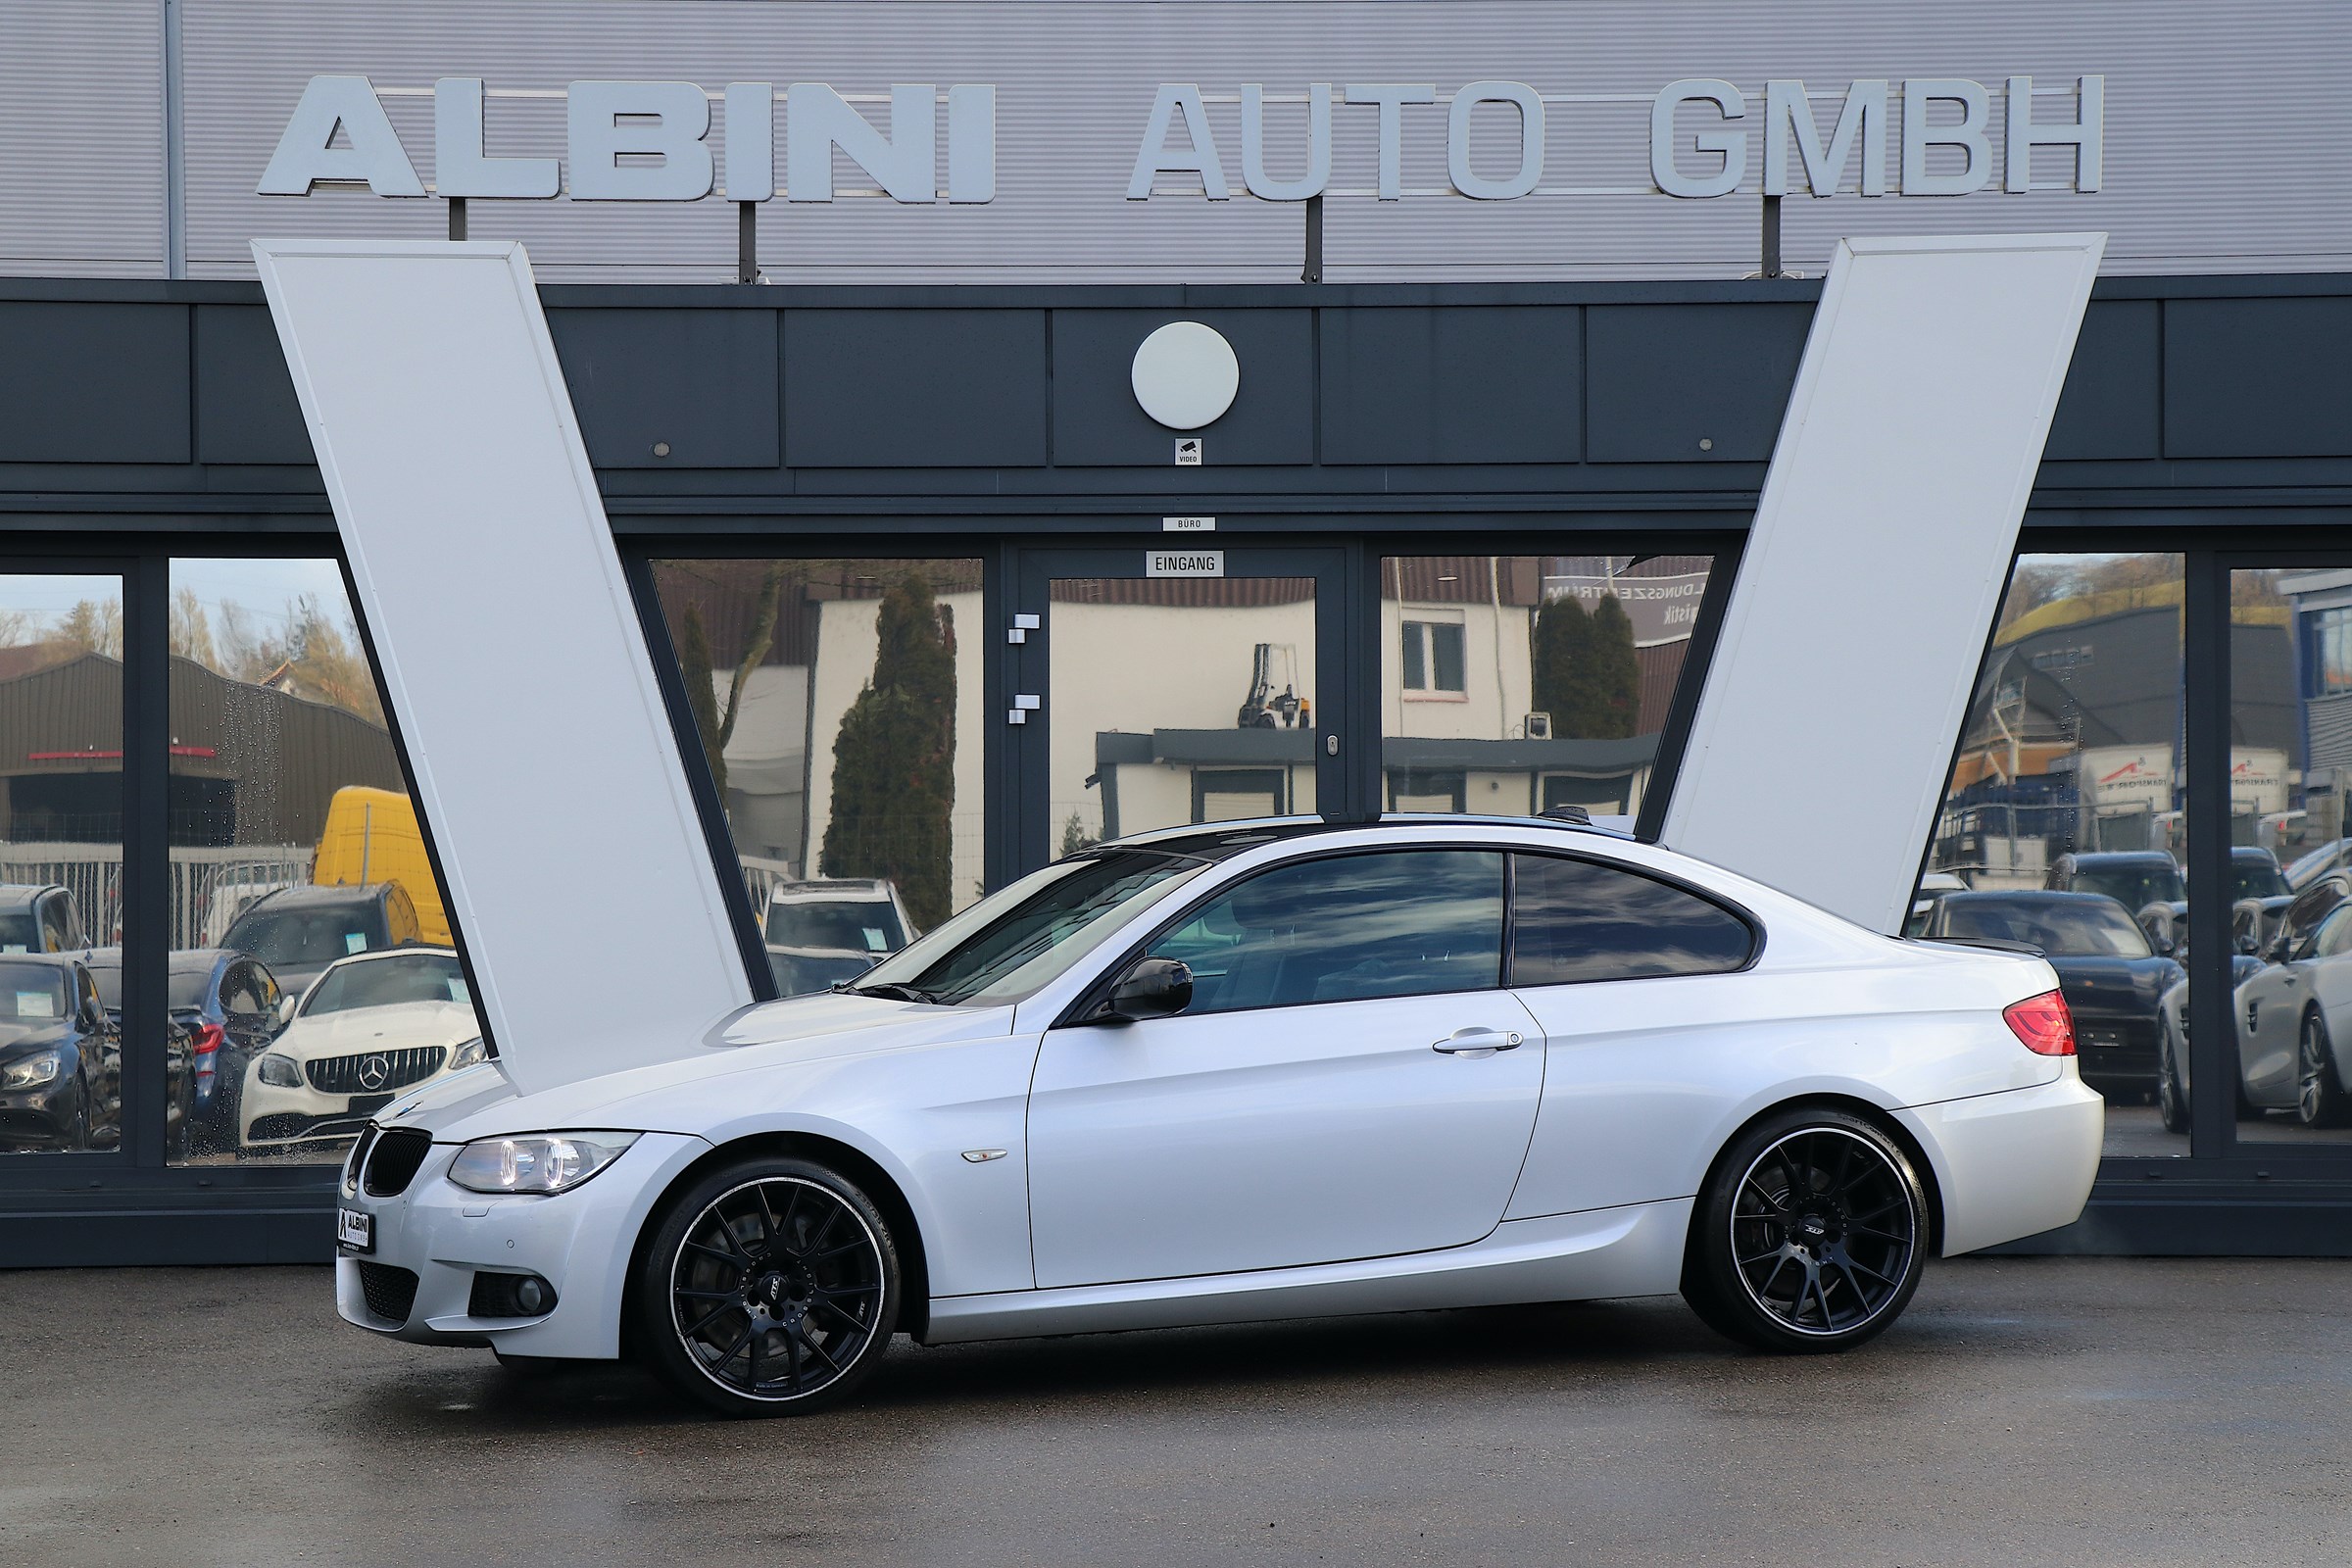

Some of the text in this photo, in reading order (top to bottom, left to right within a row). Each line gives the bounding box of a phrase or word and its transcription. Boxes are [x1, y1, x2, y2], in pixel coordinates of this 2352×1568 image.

[257, 74, 2105, 205] ALBINI AUTO GMBH
[1178, 518, 1201, 528] BÜRO
[1155, 557, 1215, 570] EINGANG
[348, 1214, 368, 1233] ALBINI
